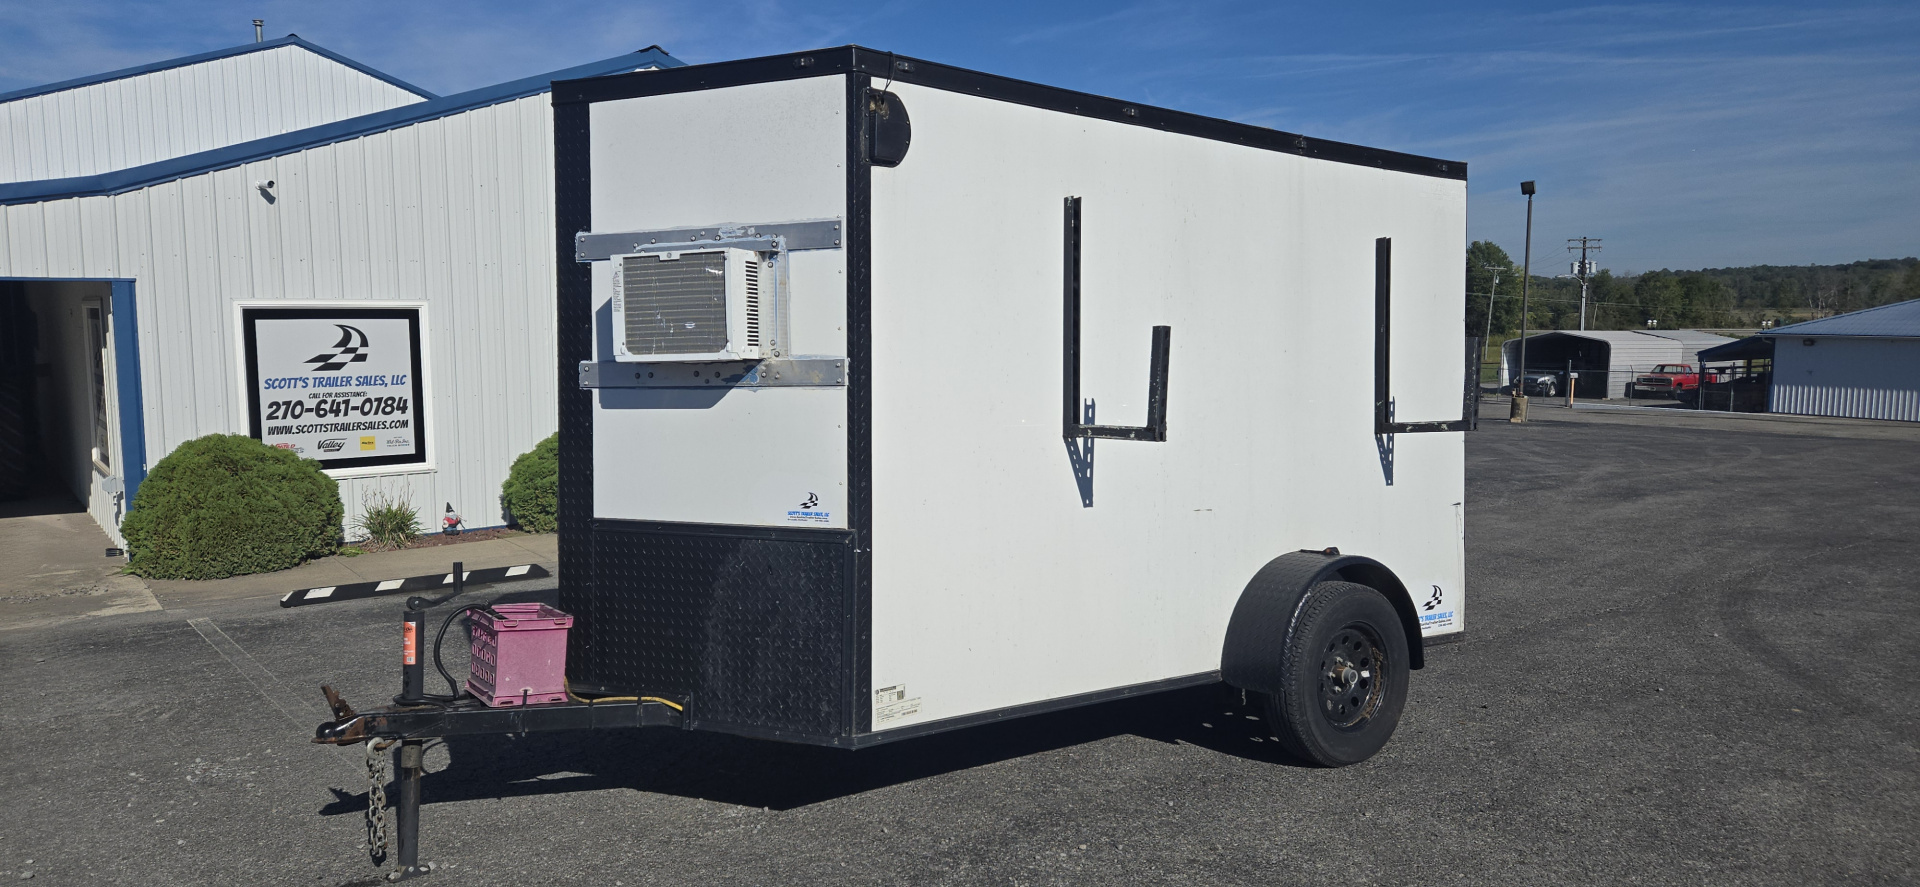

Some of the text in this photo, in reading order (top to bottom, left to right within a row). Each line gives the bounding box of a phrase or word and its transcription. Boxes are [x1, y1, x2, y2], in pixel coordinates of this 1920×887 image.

[264, 374, 407, 390] SCOTT'S TRAILER SALES, LLC
[334, 390, 368, 398] ASSISTANCE:
[266, 396, 409, 421] 270-641-0784
[267, 419, 409, 436] WWW.SCOTTSTRAILERSALES.COM
[317, 438, 347, 451] Valley
